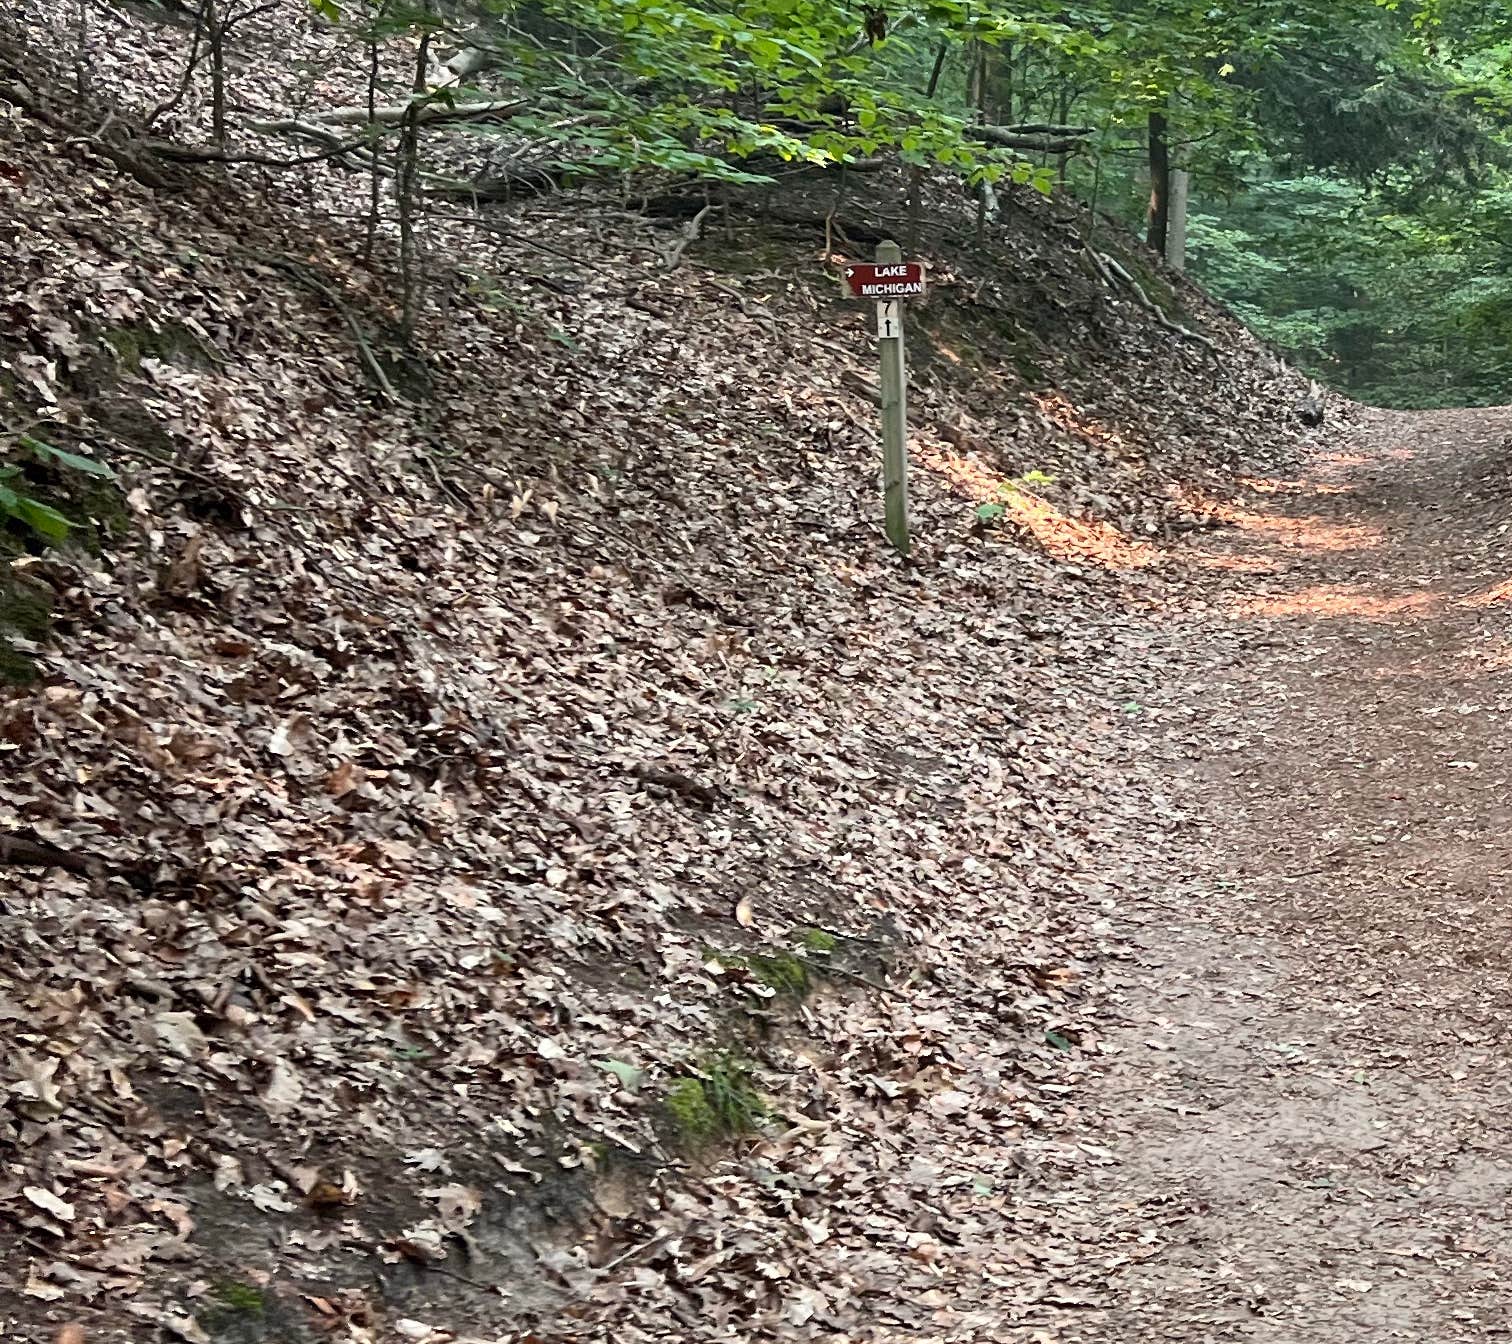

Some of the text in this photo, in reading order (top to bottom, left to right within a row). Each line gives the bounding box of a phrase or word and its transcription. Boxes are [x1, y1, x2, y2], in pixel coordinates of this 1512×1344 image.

[875, 266, 907, 277] LAKE
[862, 283, 921, 294] MICHIGAN
[882, 300, 892, 314] 7
